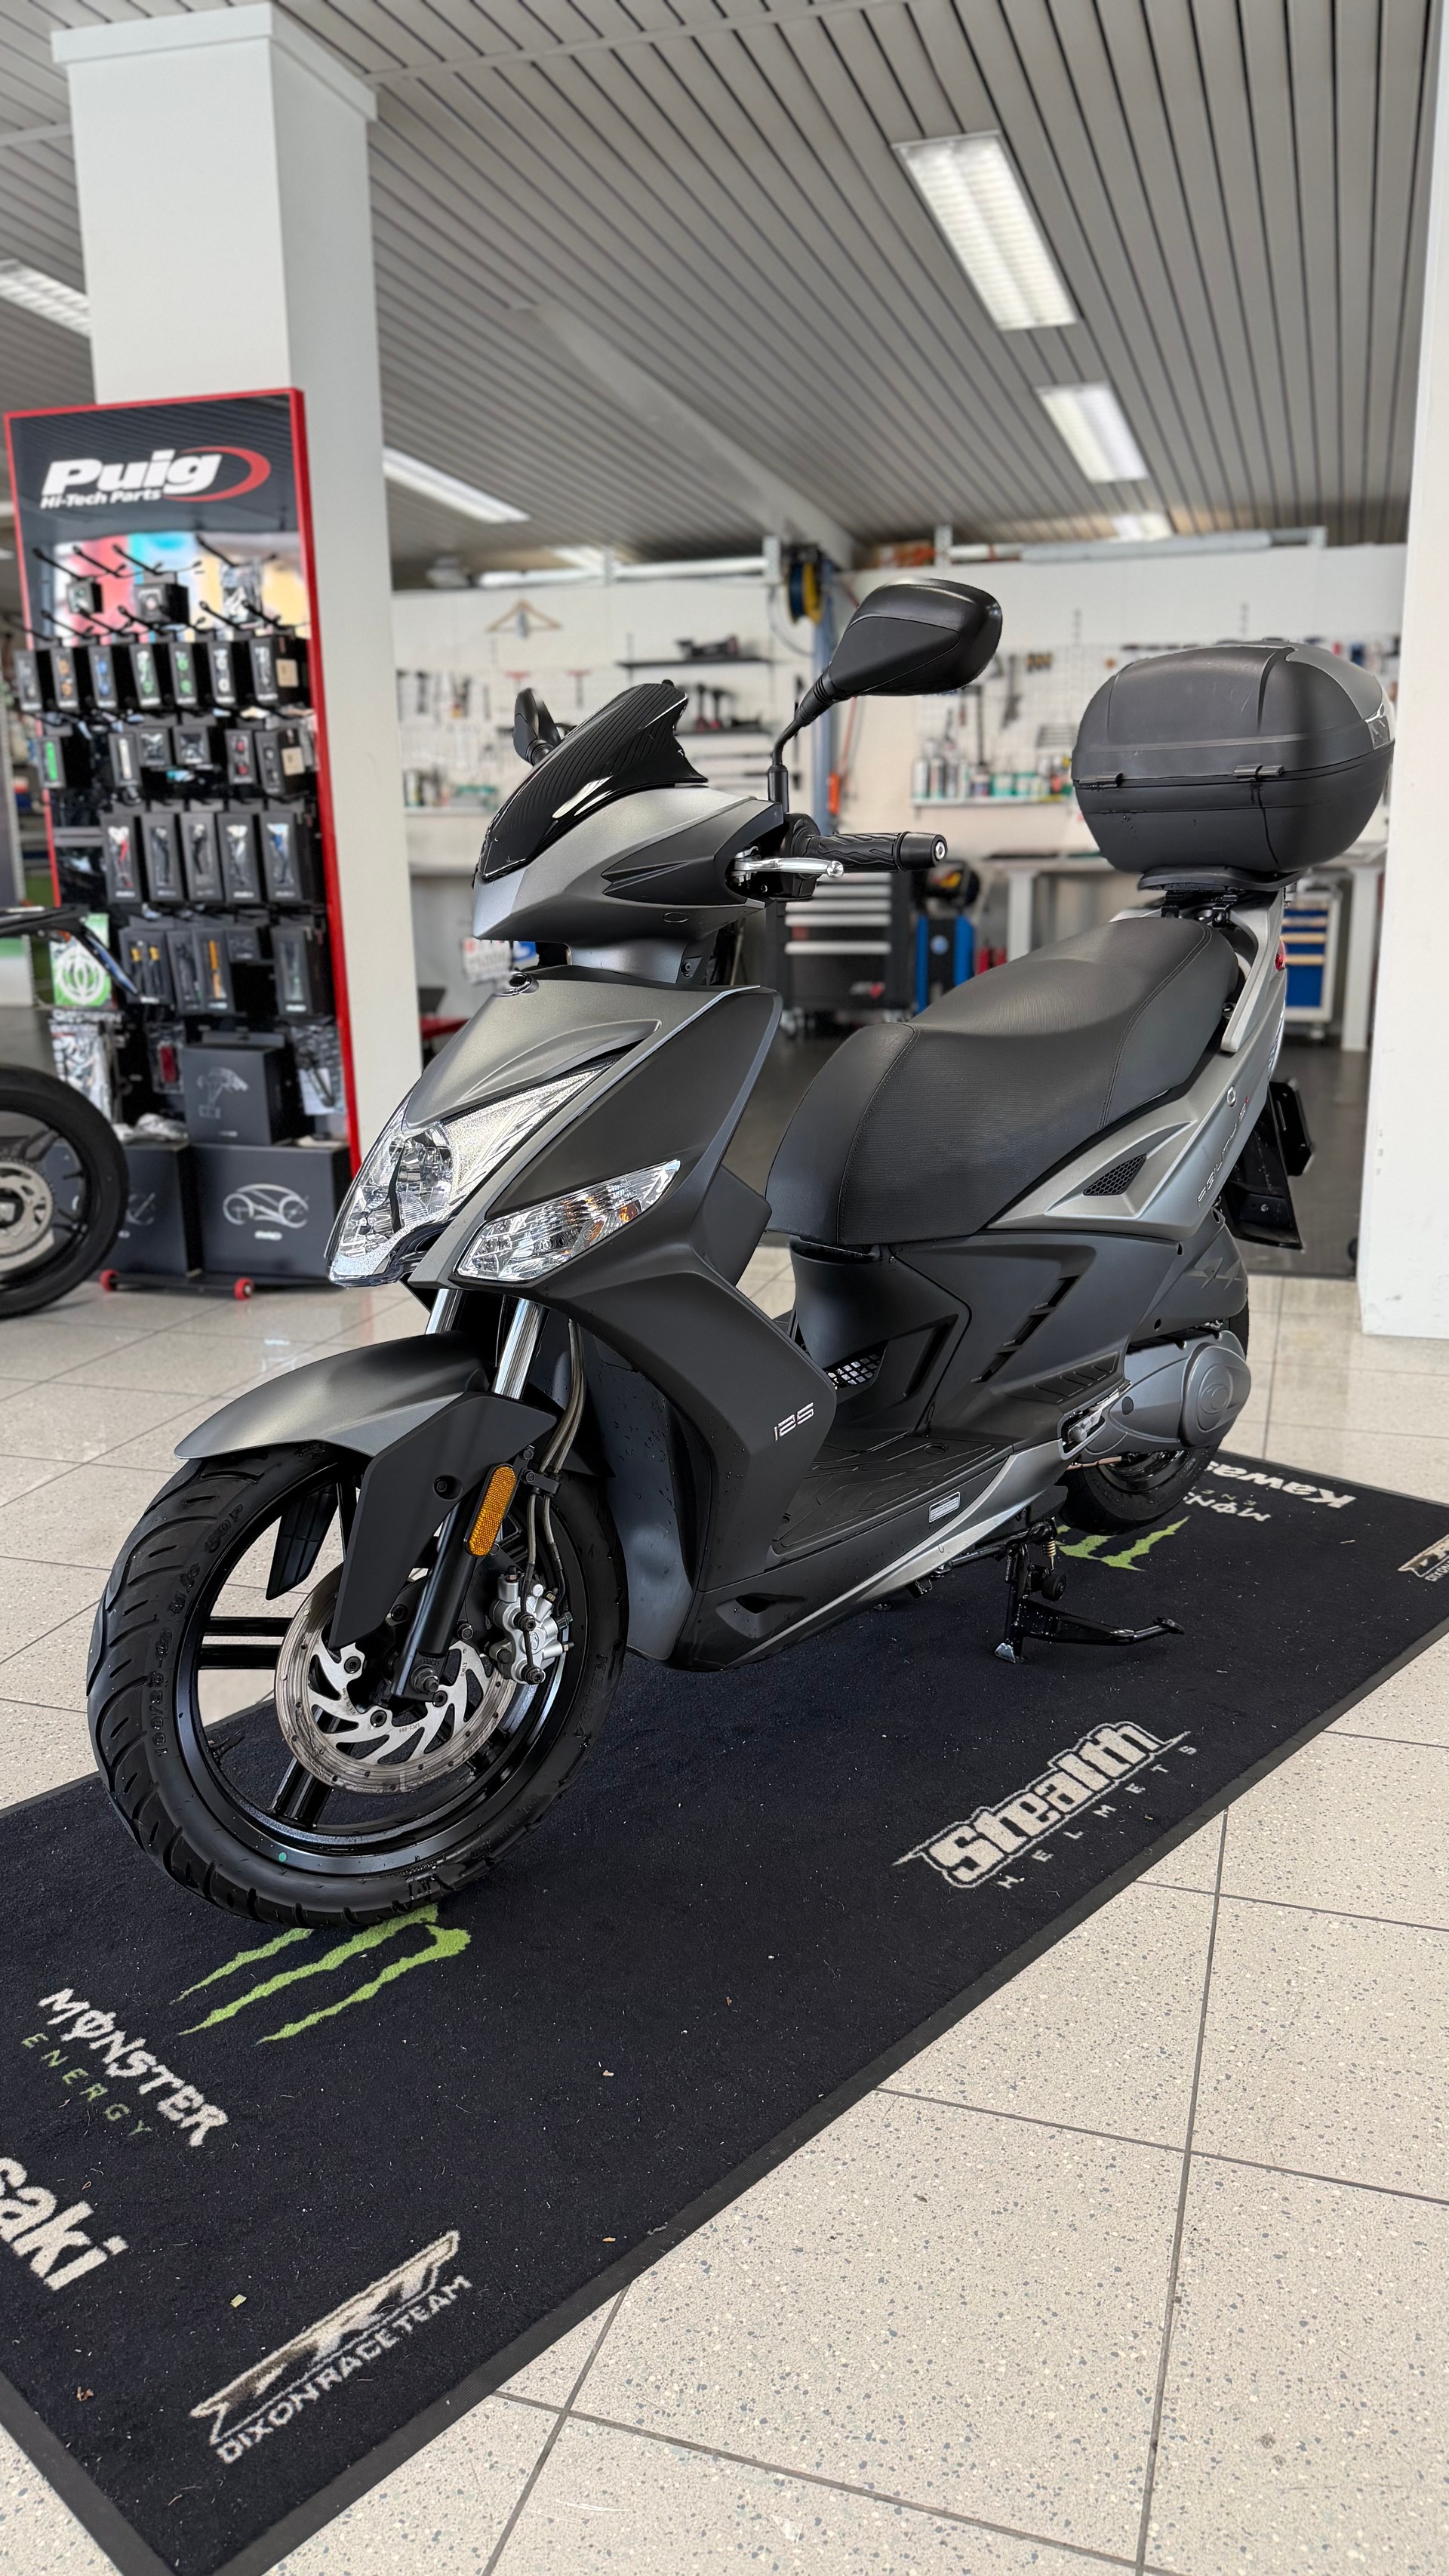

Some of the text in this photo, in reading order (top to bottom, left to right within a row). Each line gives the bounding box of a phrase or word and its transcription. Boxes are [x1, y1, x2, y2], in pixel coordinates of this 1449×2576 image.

[40, 488, 162, 509] Hi-Tech Parts
[42, 448, 223, 496] Puig
[773, 1402, 814, 1442] 125
[925, 1722, 1164, 1884] Stealth
[996, 1746, 1198, 1890] HELMETS
[21, 2033, 152, 2136] ENERGY
[216, 2274, 472, 2464] DIXON RACE TEAM
